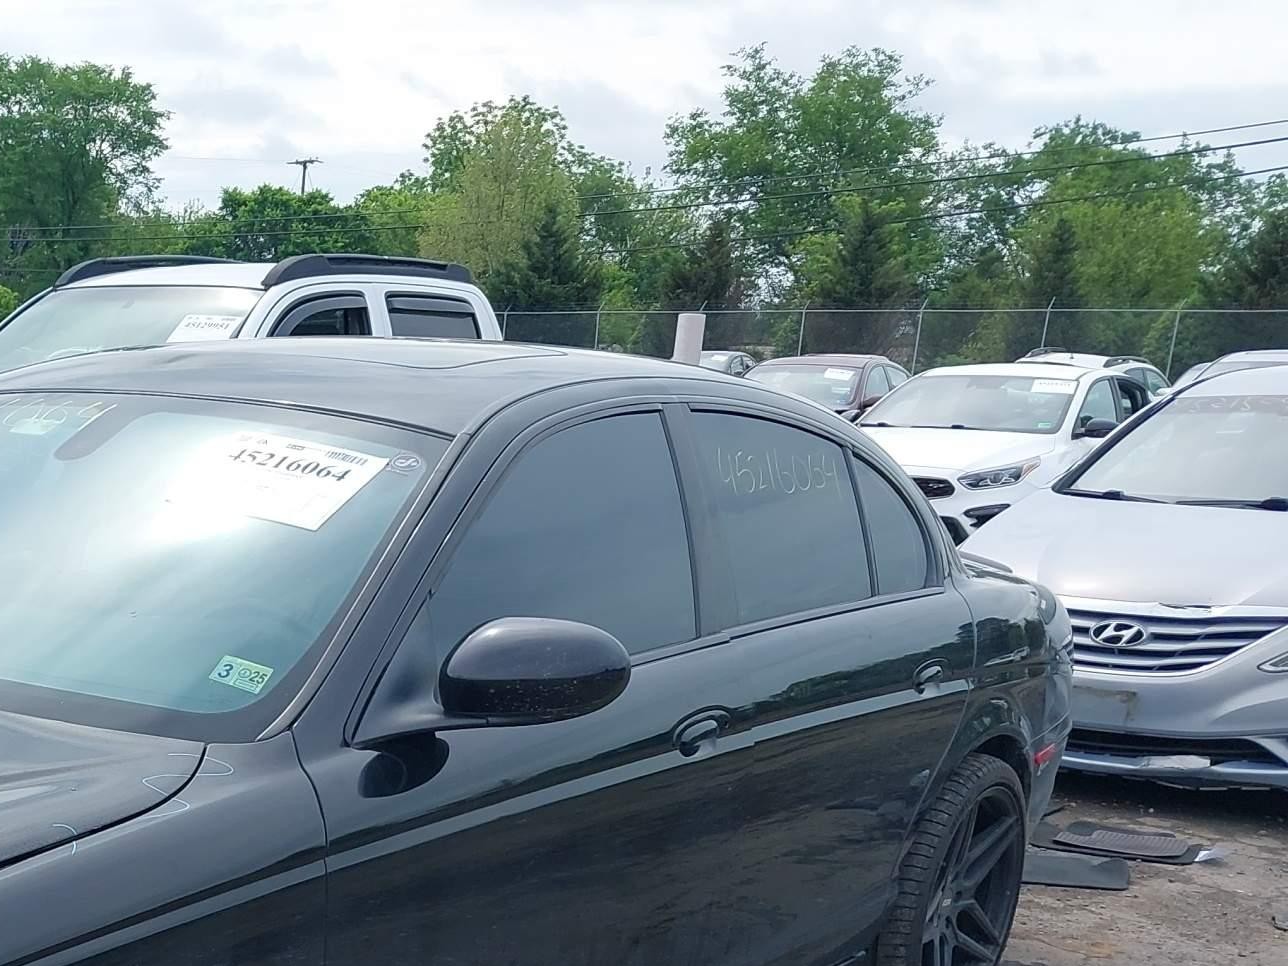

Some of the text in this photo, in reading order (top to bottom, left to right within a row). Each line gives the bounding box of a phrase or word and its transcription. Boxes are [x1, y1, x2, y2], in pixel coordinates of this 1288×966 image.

[228, 448, 352, 482] 45216064
[217, 663, 268, 685] 3 25
